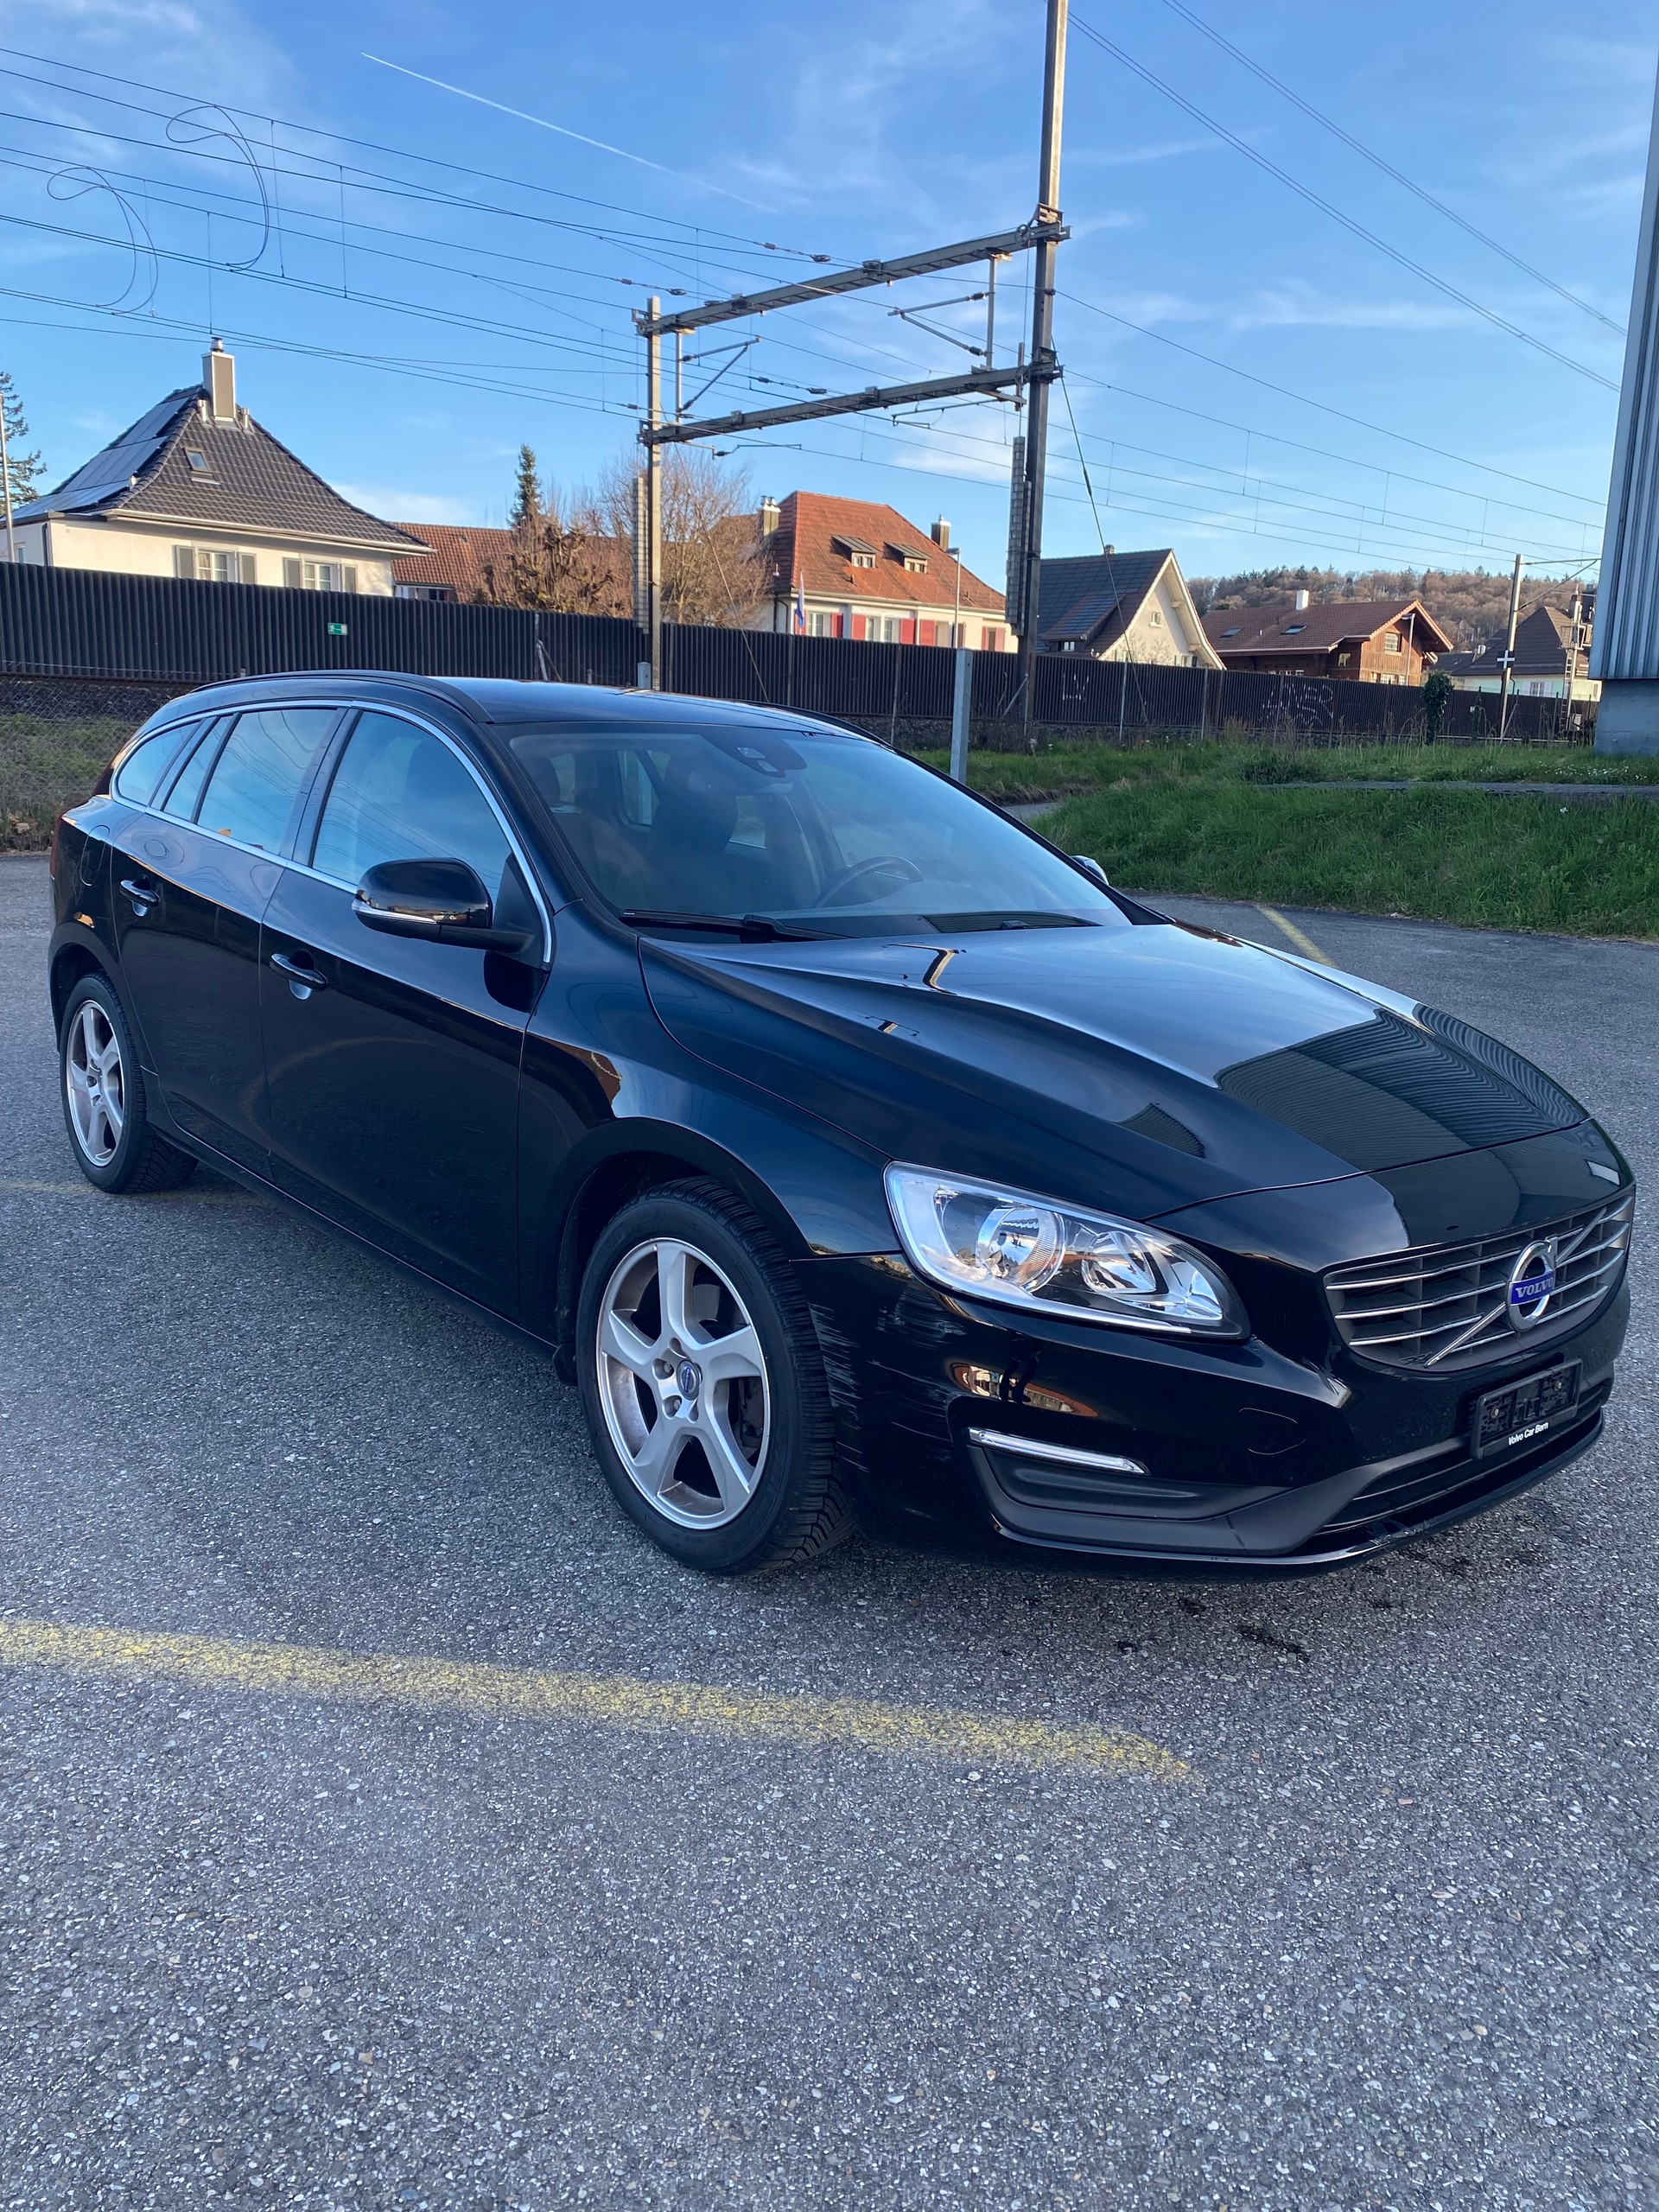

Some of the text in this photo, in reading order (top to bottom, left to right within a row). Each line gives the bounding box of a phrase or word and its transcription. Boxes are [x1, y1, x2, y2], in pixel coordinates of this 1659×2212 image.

[1516, 1277, 1554, 1298] VOLVO
[1508, 1433, 1524, 1446] Volvo
[1524, 1428, 1535, 1439] Car
